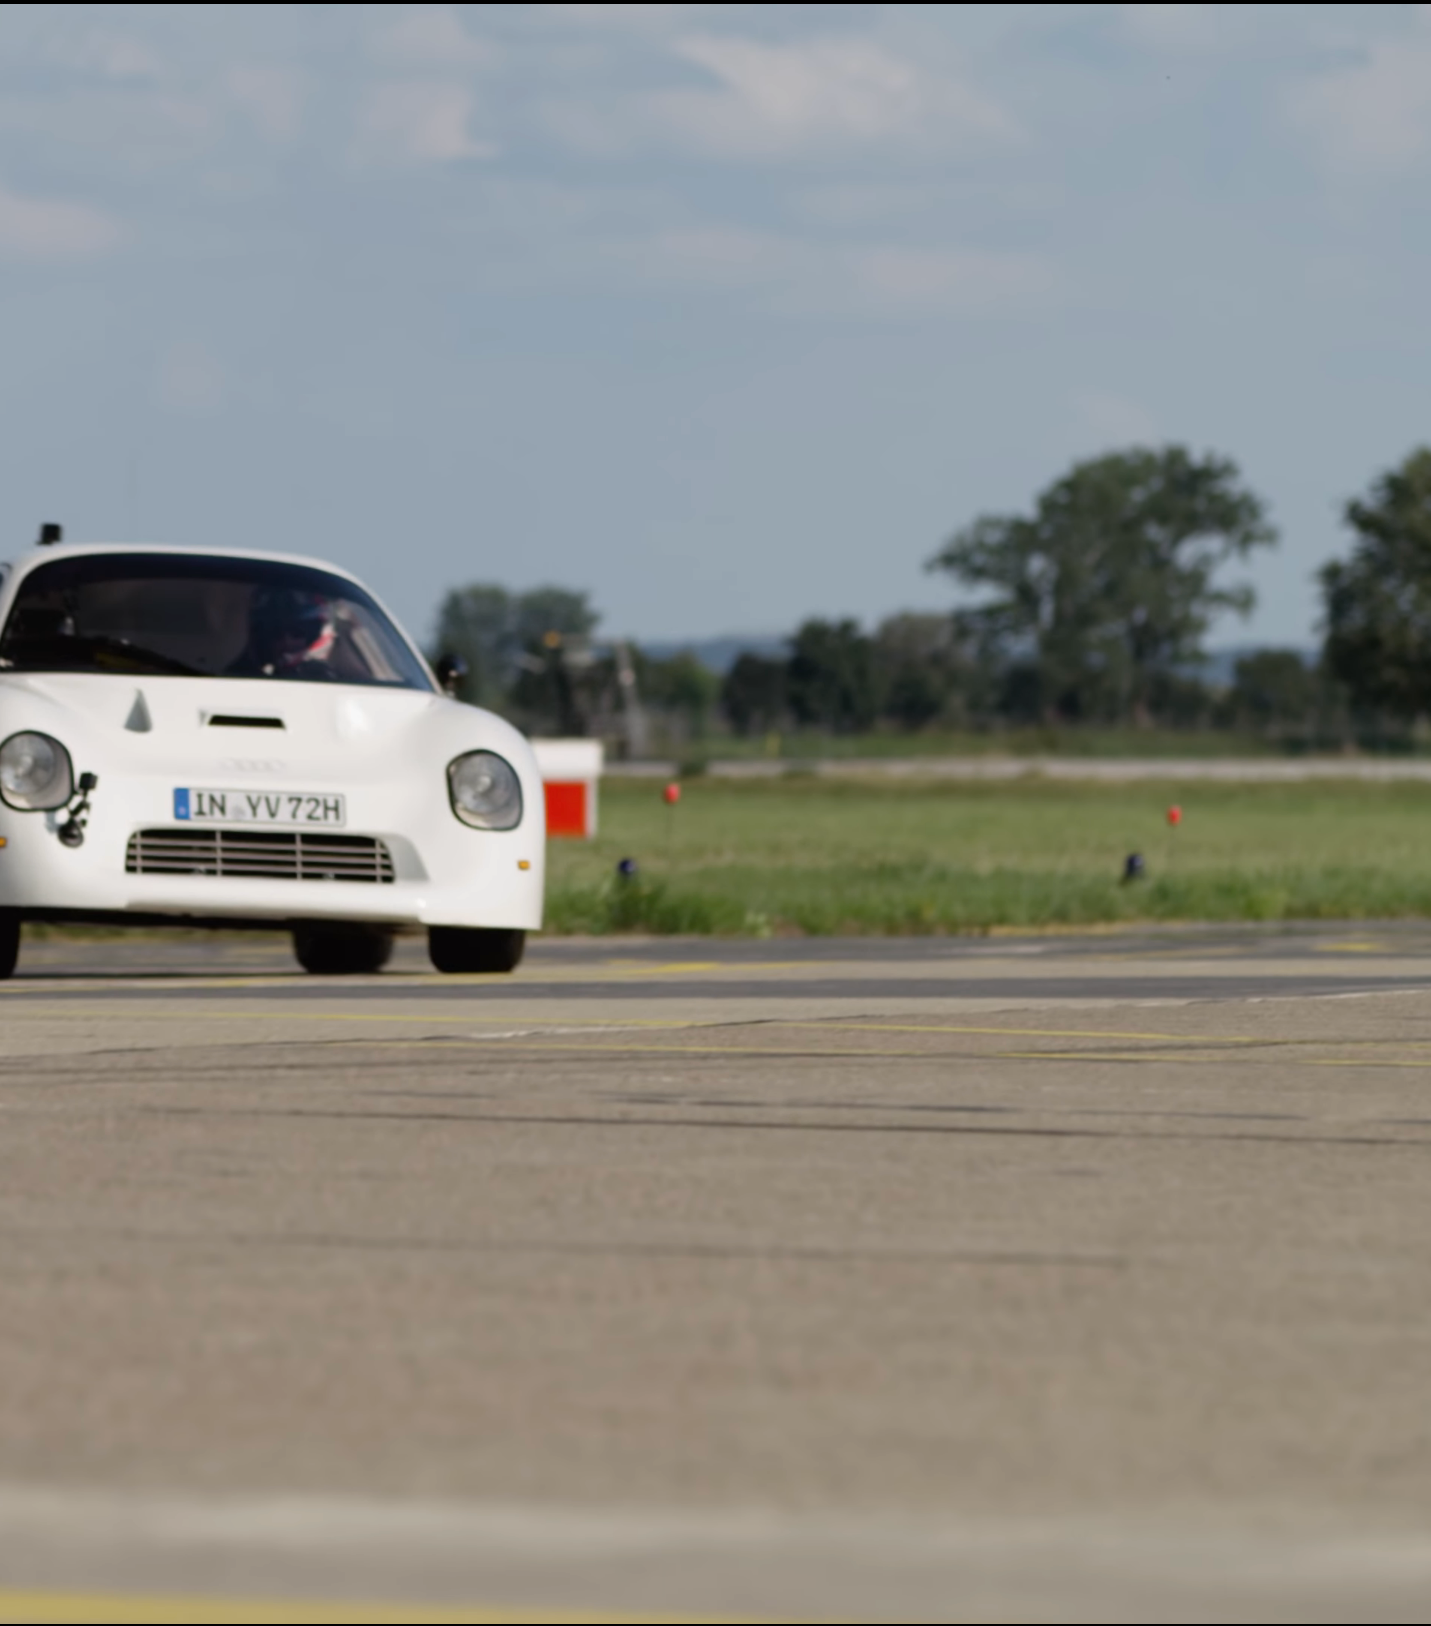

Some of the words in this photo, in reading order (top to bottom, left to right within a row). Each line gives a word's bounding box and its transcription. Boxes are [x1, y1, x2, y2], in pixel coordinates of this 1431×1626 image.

[194, 793, 226, 817] IN
[246, 794, 280, 818] YV
[288, 796, 340, 821] 72H
